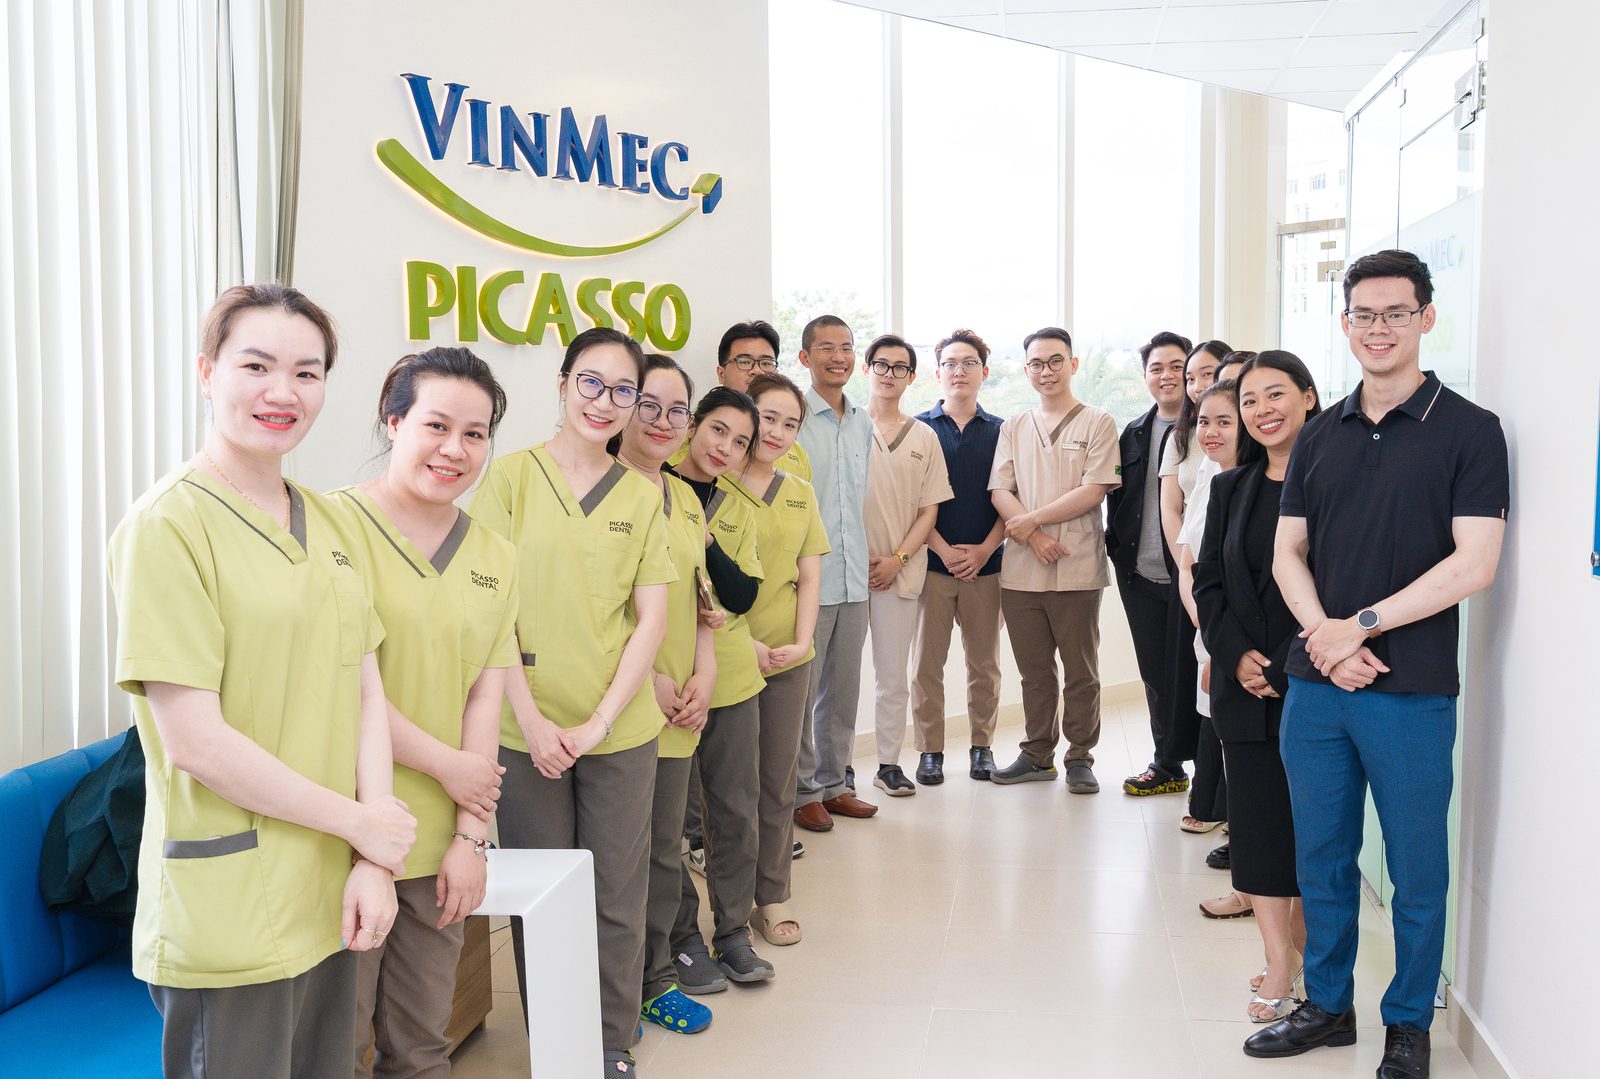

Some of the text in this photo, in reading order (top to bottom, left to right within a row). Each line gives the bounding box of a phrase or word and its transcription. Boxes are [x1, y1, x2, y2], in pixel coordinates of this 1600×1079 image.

[400, 72, 690, 201] VINMEC
[406, 260, 692, 352] PICASSO
[470, 569, 499, 585] PICASSO
[471, 576, 499, 592] DENTAL
